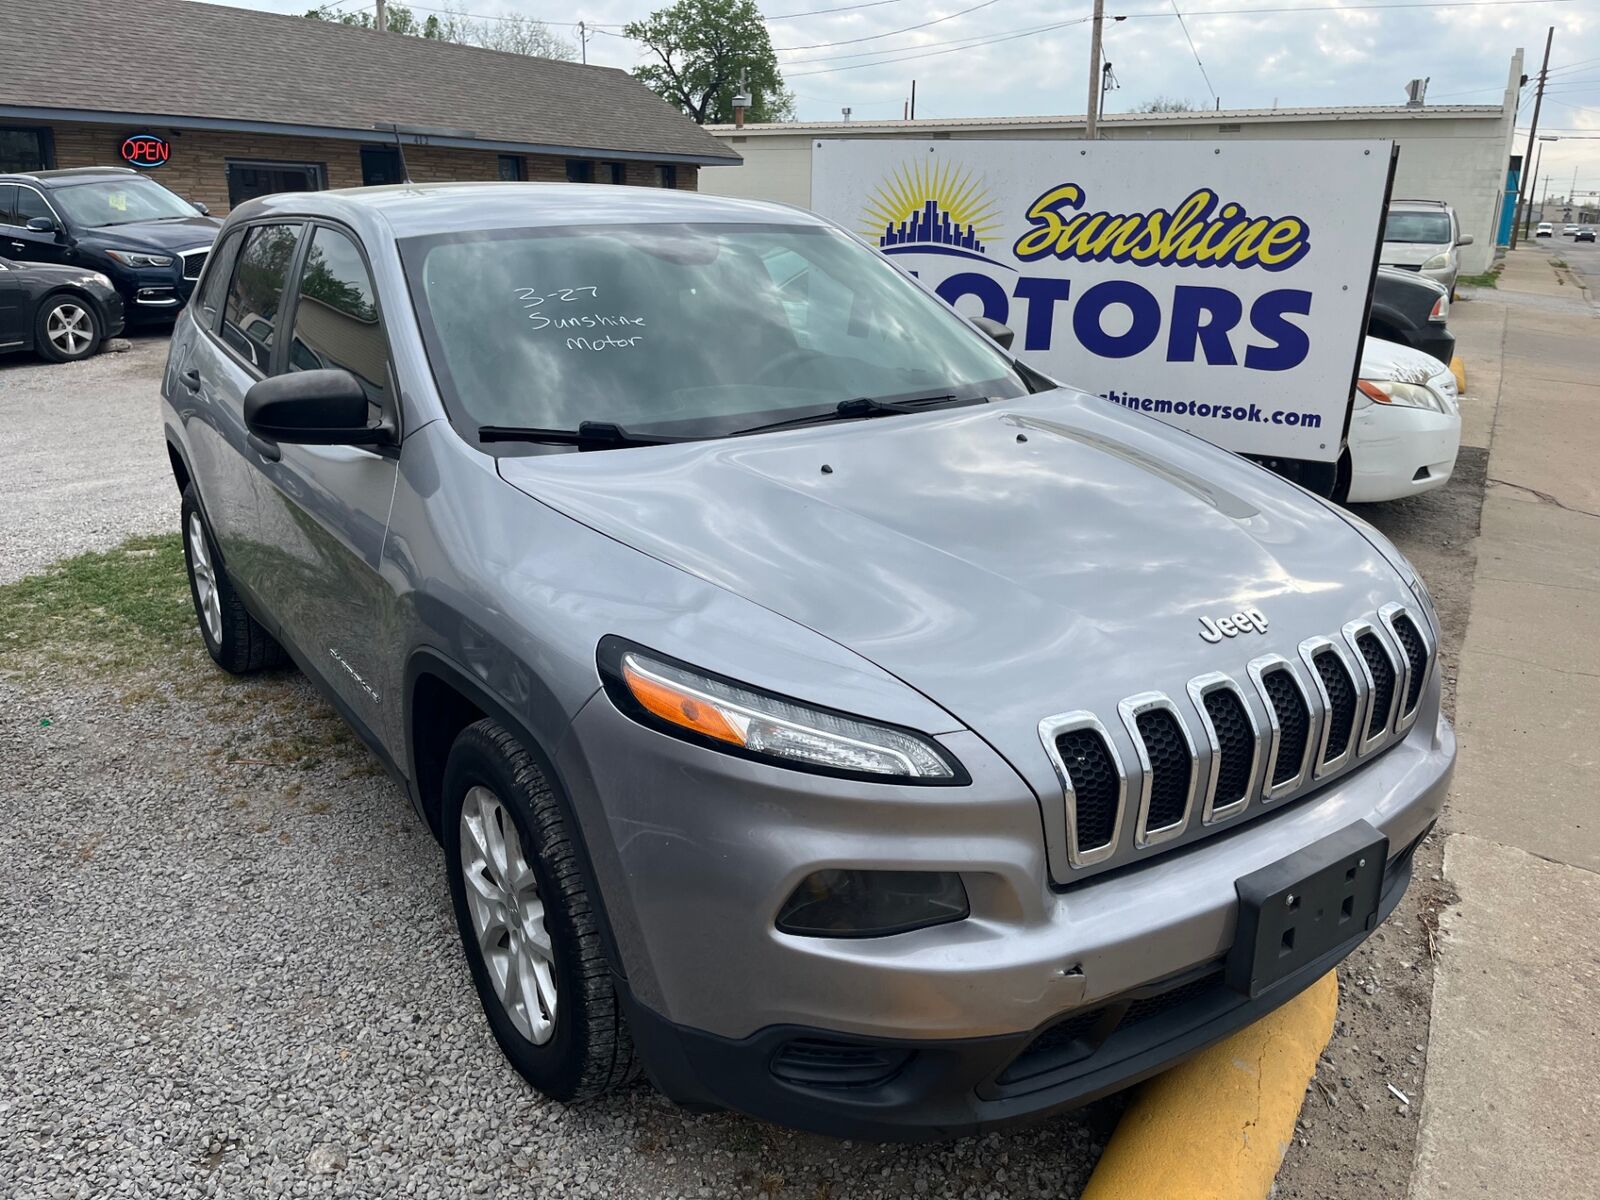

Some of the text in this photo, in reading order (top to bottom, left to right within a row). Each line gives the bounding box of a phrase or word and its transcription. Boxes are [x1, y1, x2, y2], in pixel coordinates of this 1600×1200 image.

[121, 140, 169, 161] OPEN
[1013, 182, 1310, 272] Sunshine
[513, 286, 598, 309] 3-27
[528, 311, 647, 330] Sunshine
[908, 270, 1313, 372] OTORS
[1099, 390, 1322, 428] hinemotorsok.com
[1198, 607, 1269, 644] Jeep
